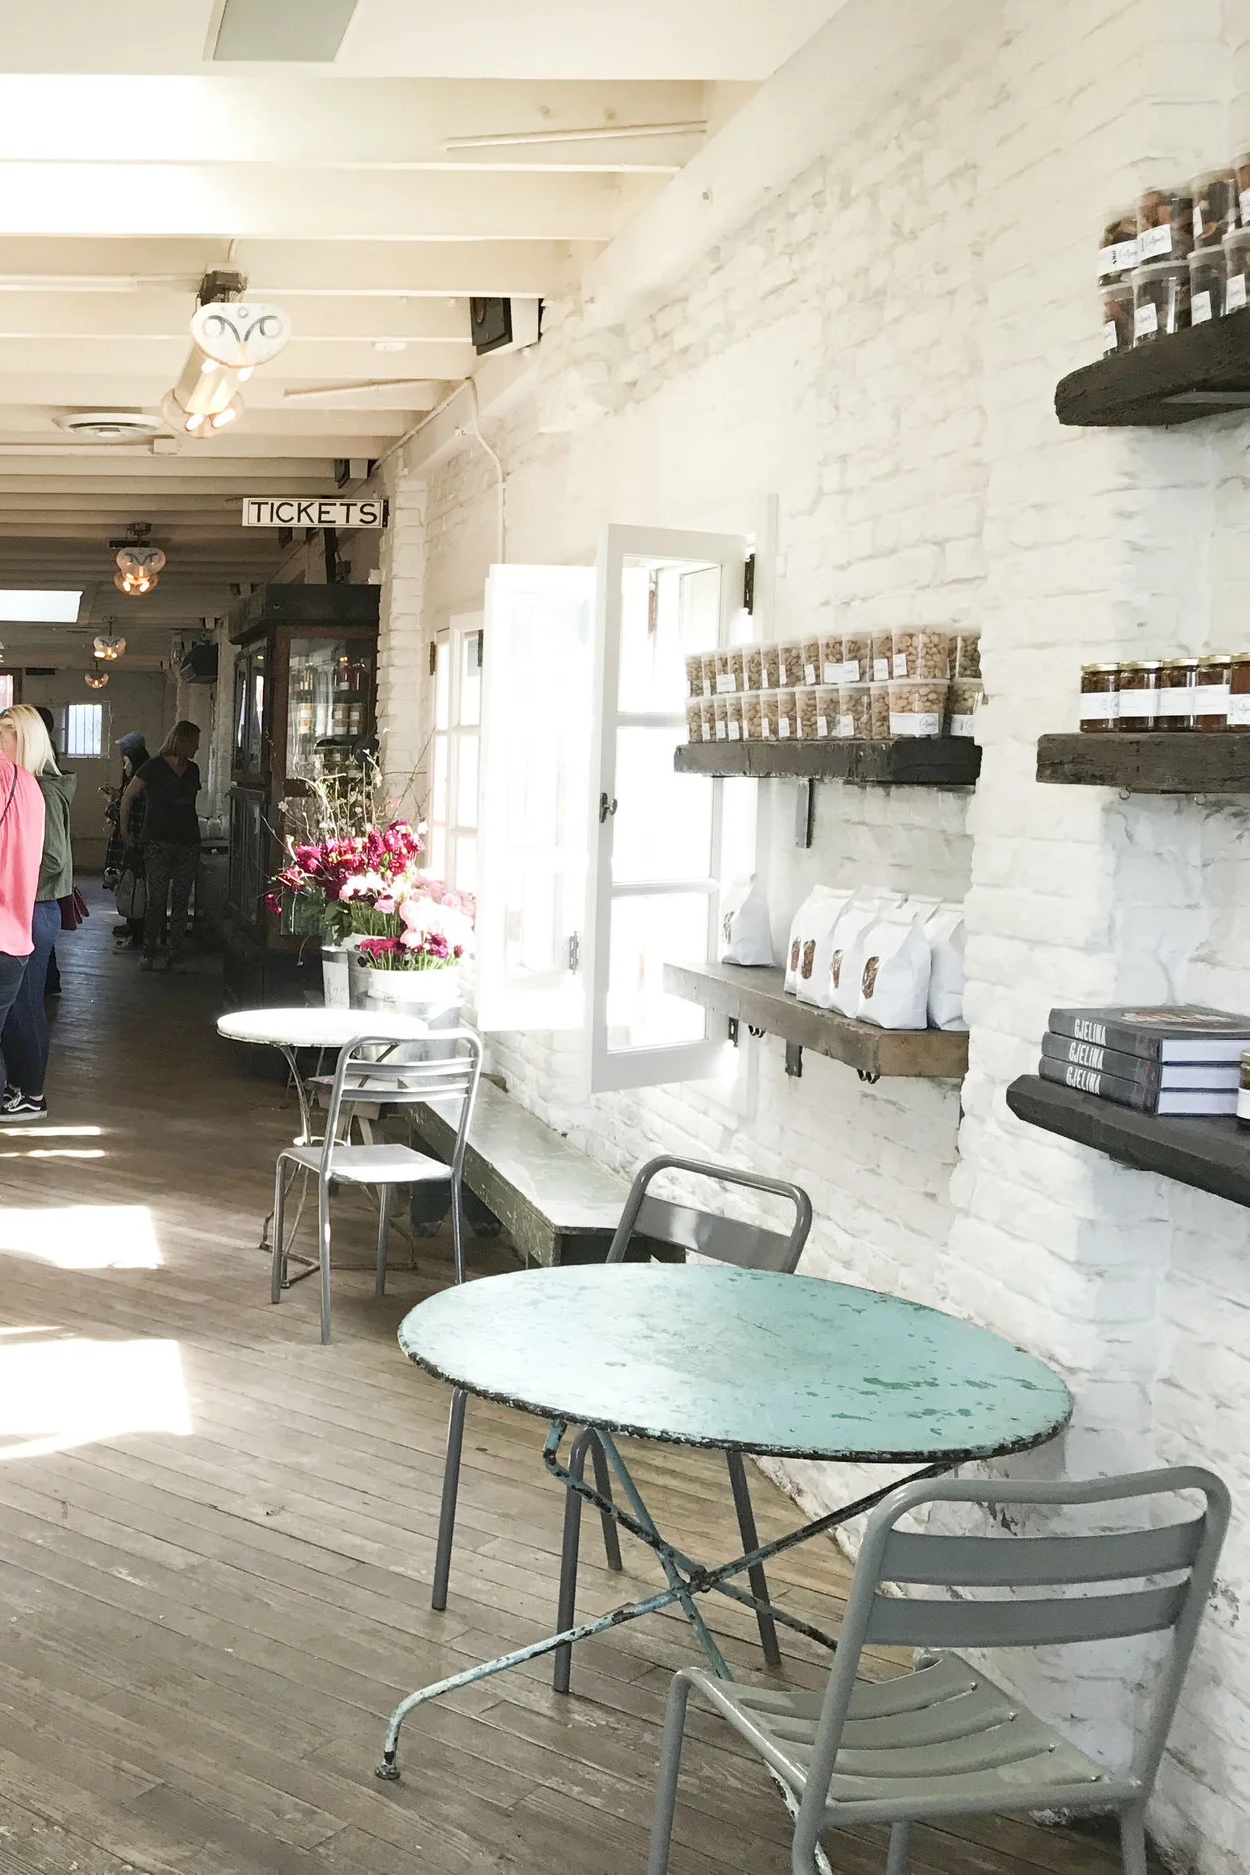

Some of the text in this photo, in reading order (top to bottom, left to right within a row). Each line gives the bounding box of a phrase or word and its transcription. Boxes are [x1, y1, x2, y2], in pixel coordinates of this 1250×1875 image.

[251, 502, 378, 525] TICKETS
[1075, 1018, 1106, 1046] GJELINA
[1068, 1042, 1103, 1070] GJELINA
[1065, 1066, 1100, 1095] GJELINA
